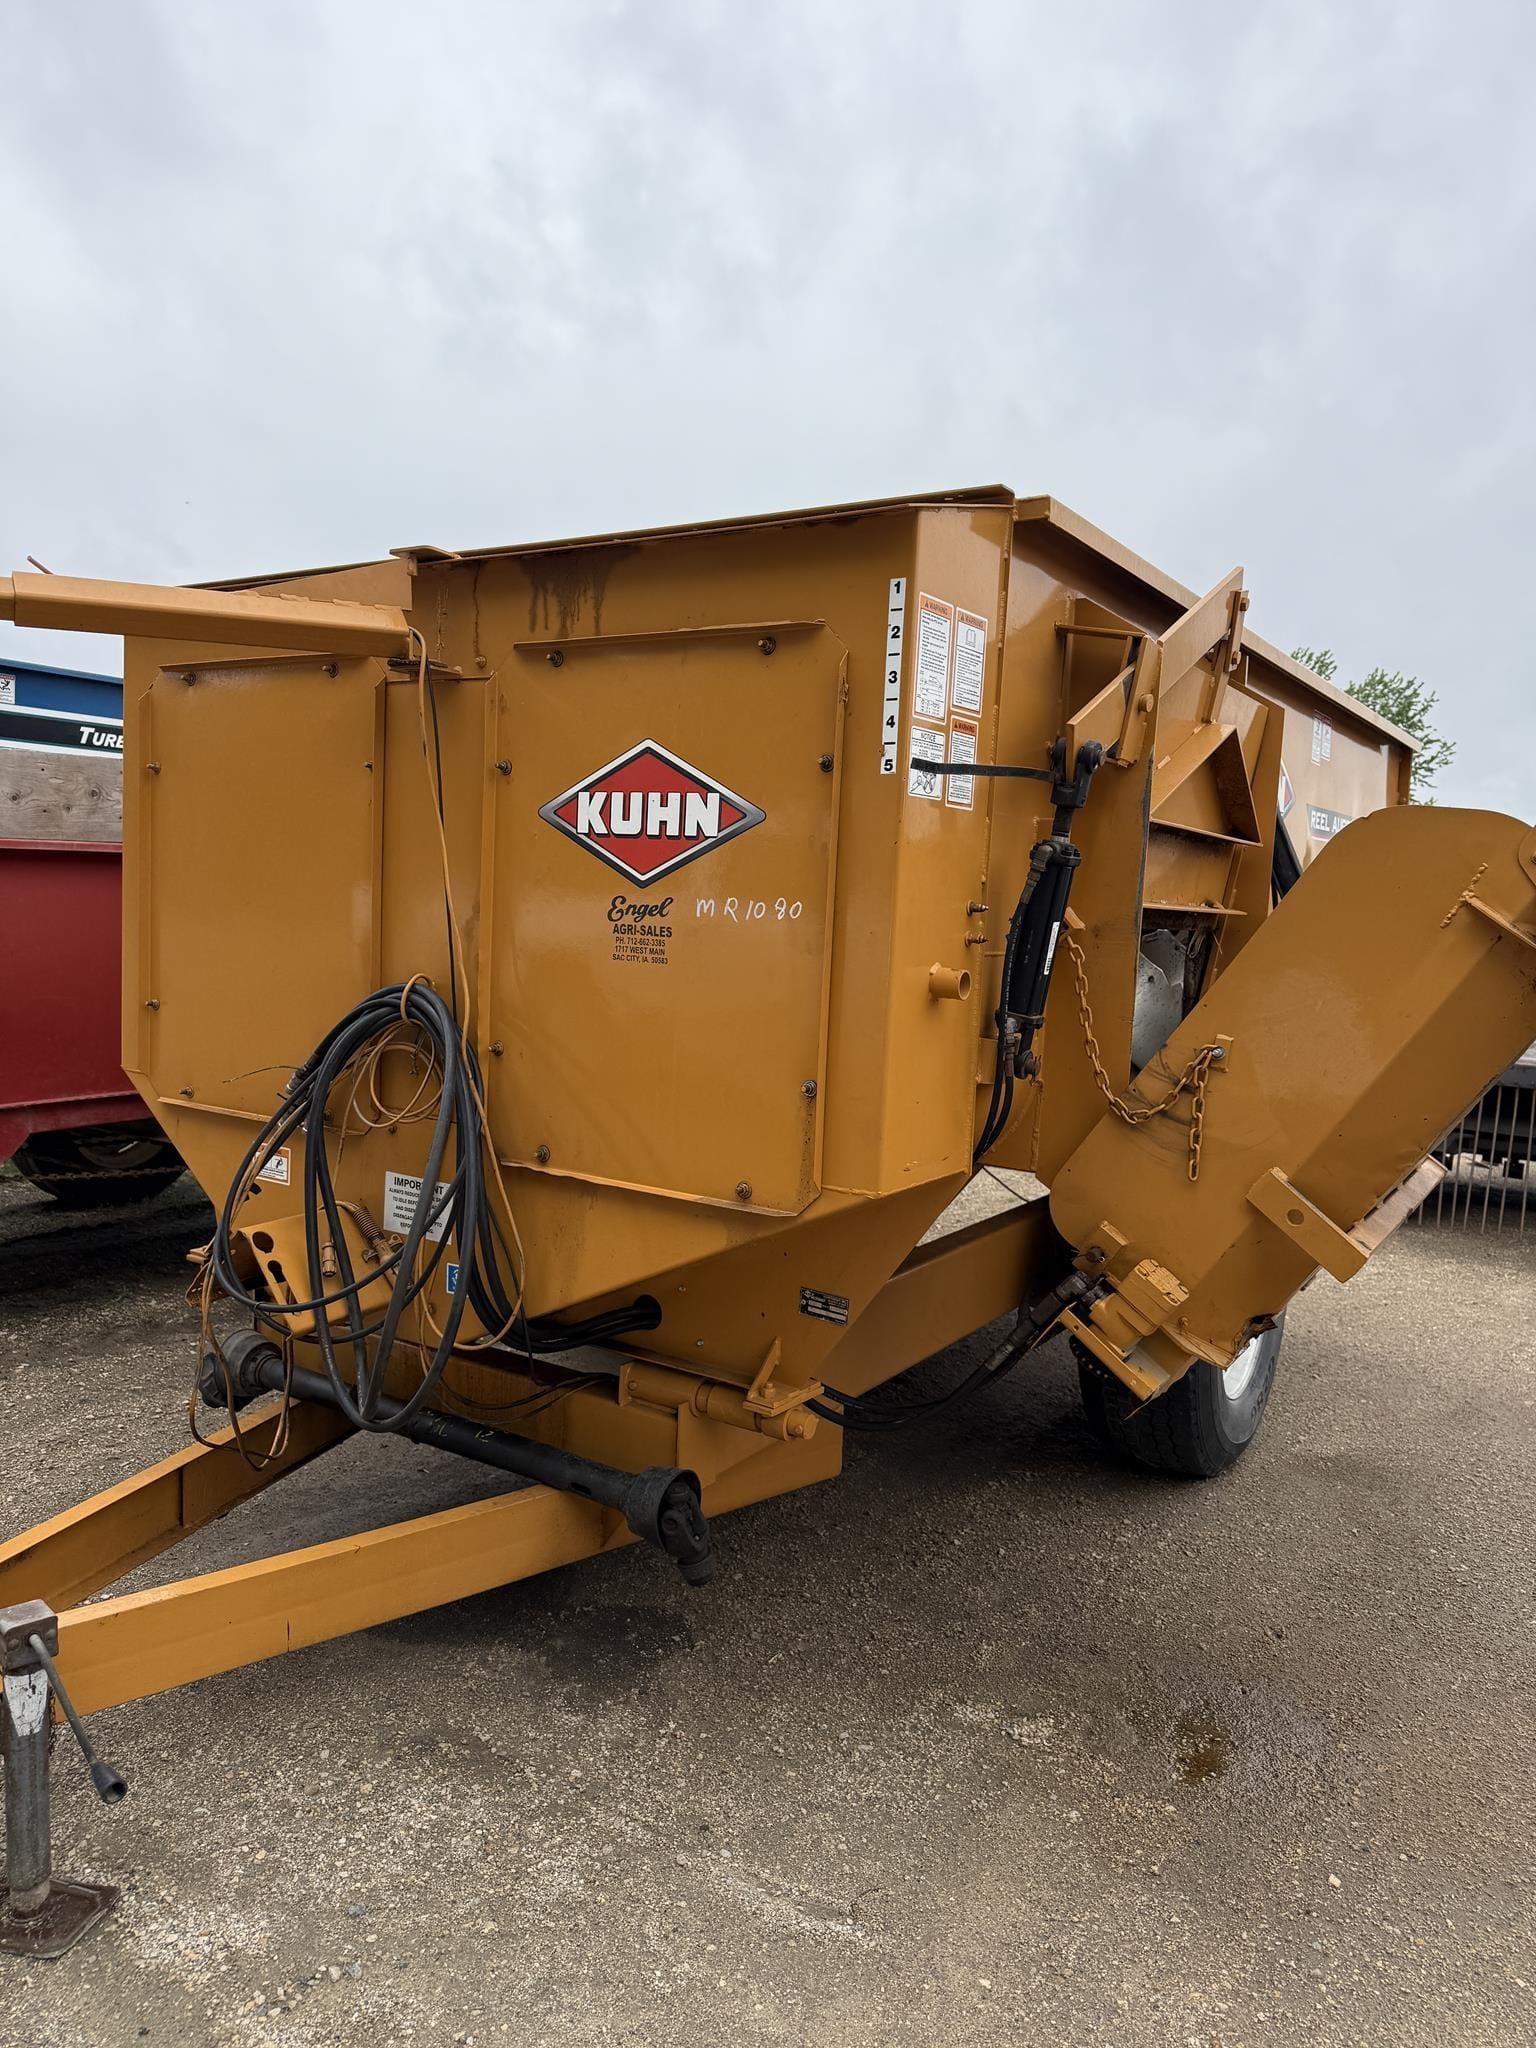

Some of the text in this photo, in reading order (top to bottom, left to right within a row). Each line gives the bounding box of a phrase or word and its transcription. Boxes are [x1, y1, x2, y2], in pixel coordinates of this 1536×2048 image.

[893, 580, 901, 594] 1
[890, 625, 901, 639] 2
[888, 670, 898, 685] 3
[885, 715, 896, 729] 4
[920, 732, 936, 744] NOTICE
[884, 758, 894, 773] 5
[576, 791, 721, 838] KUHN
[1311, 810, 1330, 831] REEL
[607, 895, 674, 923] Engel
[612, 923, 673, 938] AGRI-SALES
[612, 953, 625, 961] SAC
[615, 945, 665, 956] 1717 WEST MAIN
[394, 1176, 444, 1195] IMPORNT
[404, 1190, 420, 1198] REDUC
